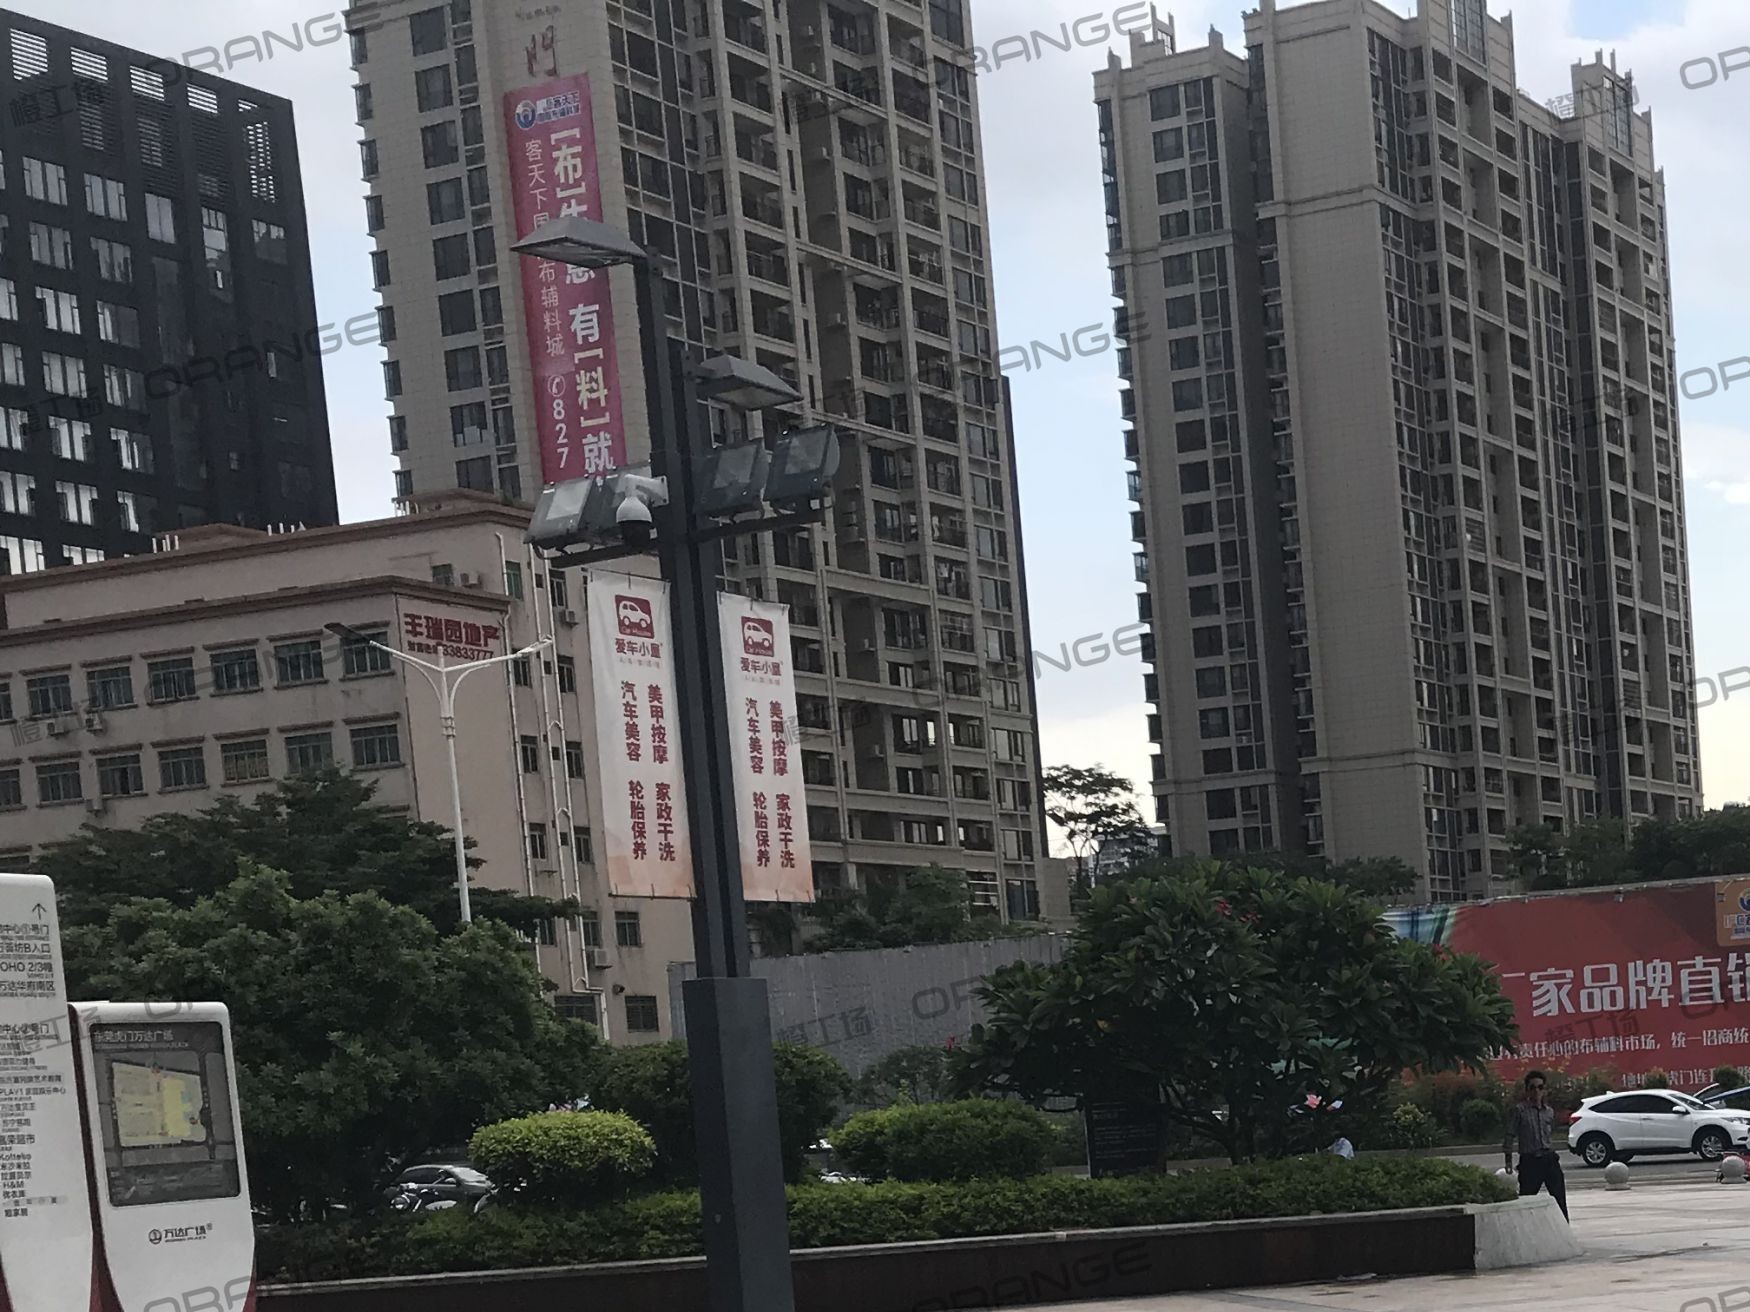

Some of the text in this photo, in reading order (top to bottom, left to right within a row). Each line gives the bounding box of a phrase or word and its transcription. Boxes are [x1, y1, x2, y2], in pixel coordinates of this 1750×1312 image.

[525, 140, 564, 356] 客天下国布辅料城
[621, 681, 641, 762] 汽车美容
[745, 697, 764, 774] 汽车美容
[648, 685, 675, 861] 美甲按摩 家政干洗
[769, 701, 795, 869] 美甲按摩 家政干洗
[628, 780, 647, 860] 轮胎保养
[753, 792, 770, 868] 轮胎保养
[0, 961, 26, 973] OHO
